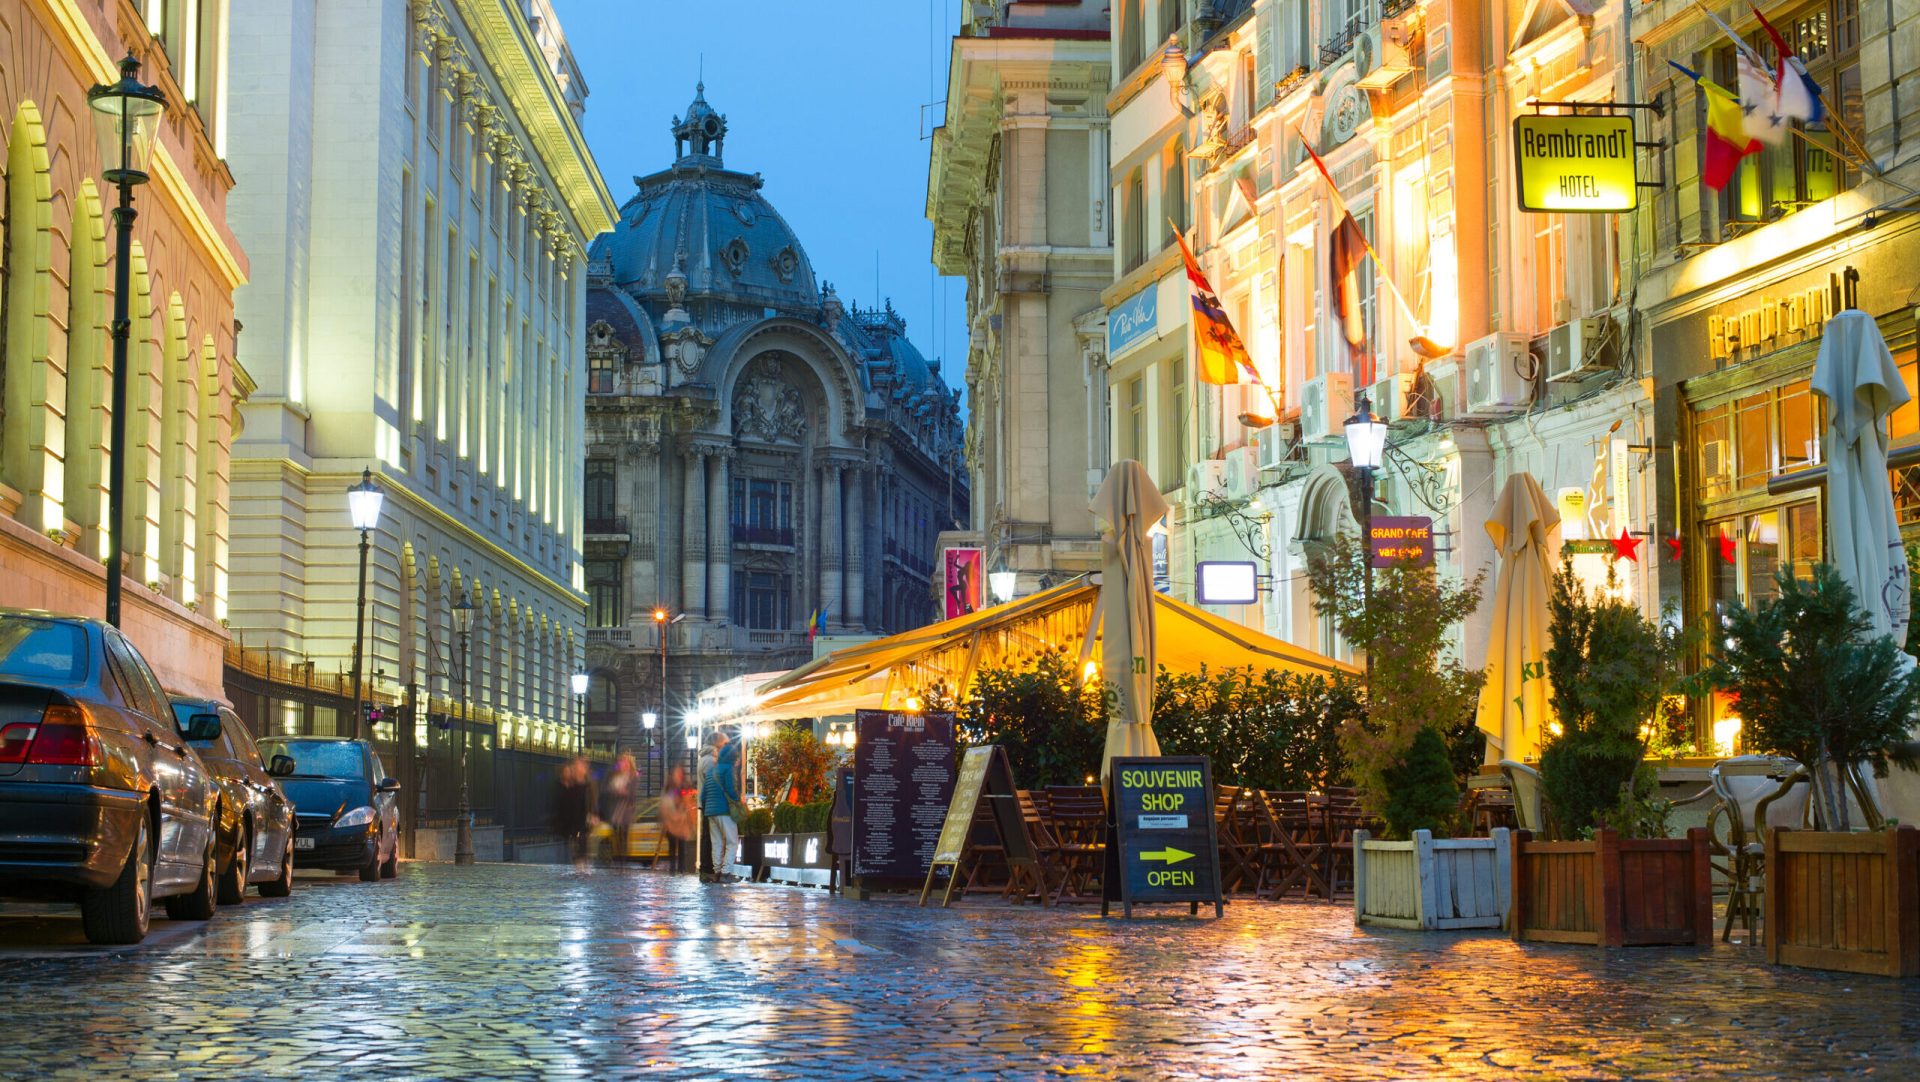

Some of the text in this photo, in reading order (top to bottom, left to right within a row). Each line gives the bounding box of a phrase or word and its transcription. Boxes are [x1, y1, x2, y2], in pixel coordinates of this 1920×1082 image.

[1559, 175, 1600, 198] HOTEL
[1371, 528, 1404, 538] GRAND
[1379, 547, 1396, 557] van
[888, 713, 905, 727] Café
[1122, 770, 1204, 788] SOUVENIR
[1141, 793, 1185, 811] SHOP
[1147, 871, 1194, 886] OPEN
